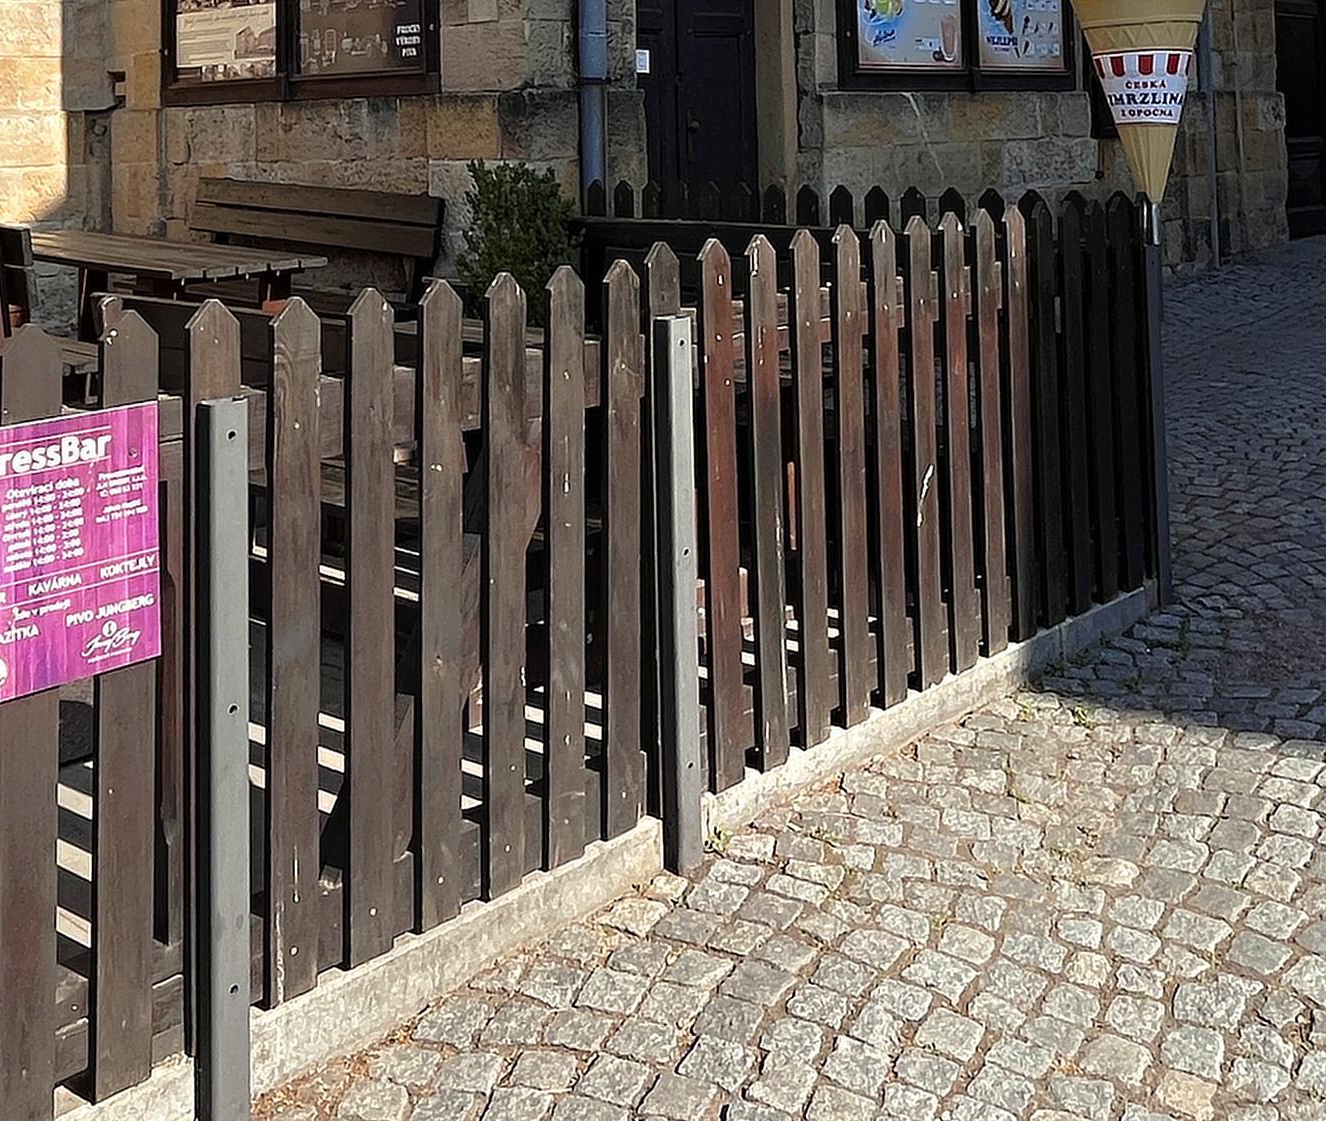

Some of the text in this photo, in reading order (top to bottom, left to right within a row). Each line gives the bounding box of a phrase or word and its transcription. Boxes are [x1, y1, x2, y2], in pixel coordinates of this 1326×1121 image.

[28, 573, 83, 596] KAVÁRNA
[66, 593, 156, 628] PIVO JUNGBERG
